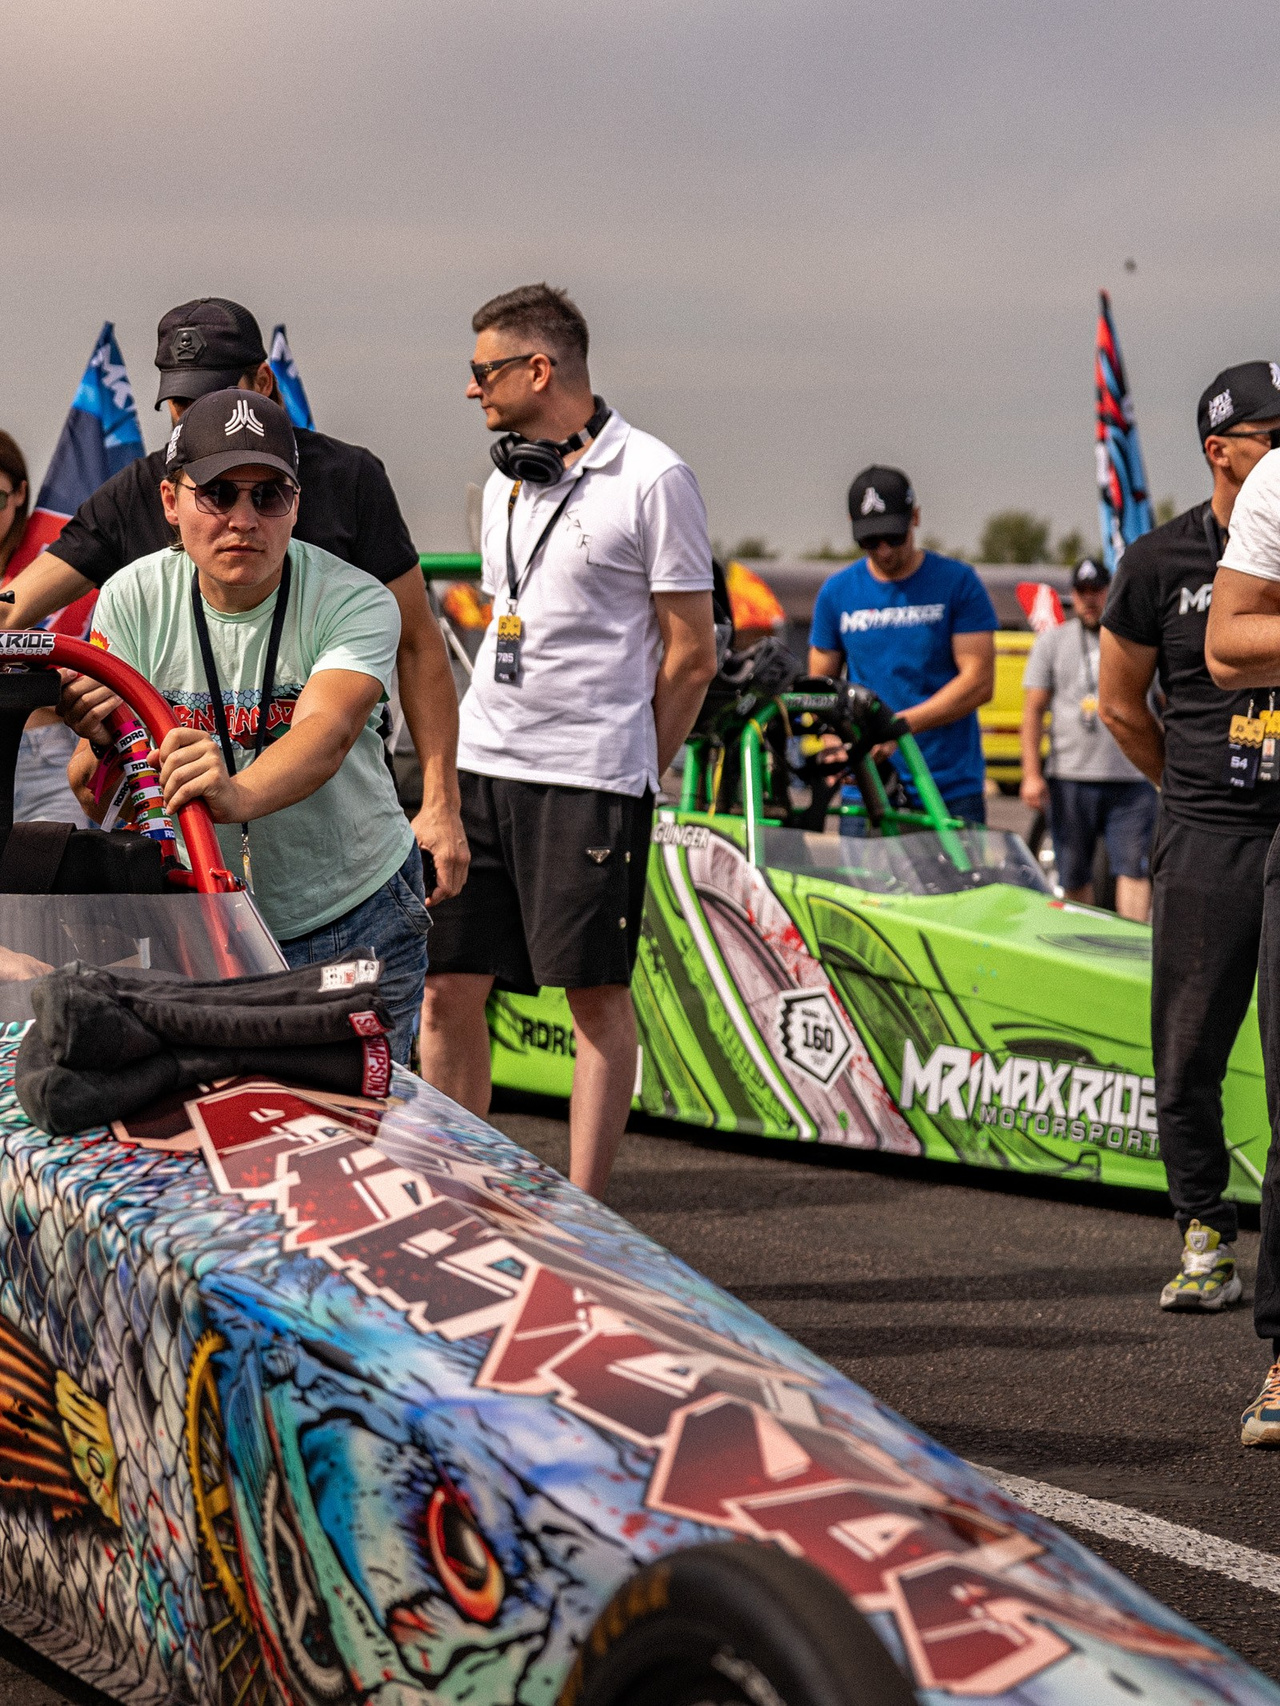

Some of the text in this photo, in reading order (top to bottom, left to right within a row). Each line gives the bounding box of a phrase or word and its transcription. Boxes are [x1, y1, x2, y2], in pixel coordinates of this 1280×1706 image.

[172, 699, 296, 736] BARRACUD
[119, 729, 145, 748] RDRC
[1230, 755, 1248, 769] 54
[802, 1022, 834, 1053] 160
